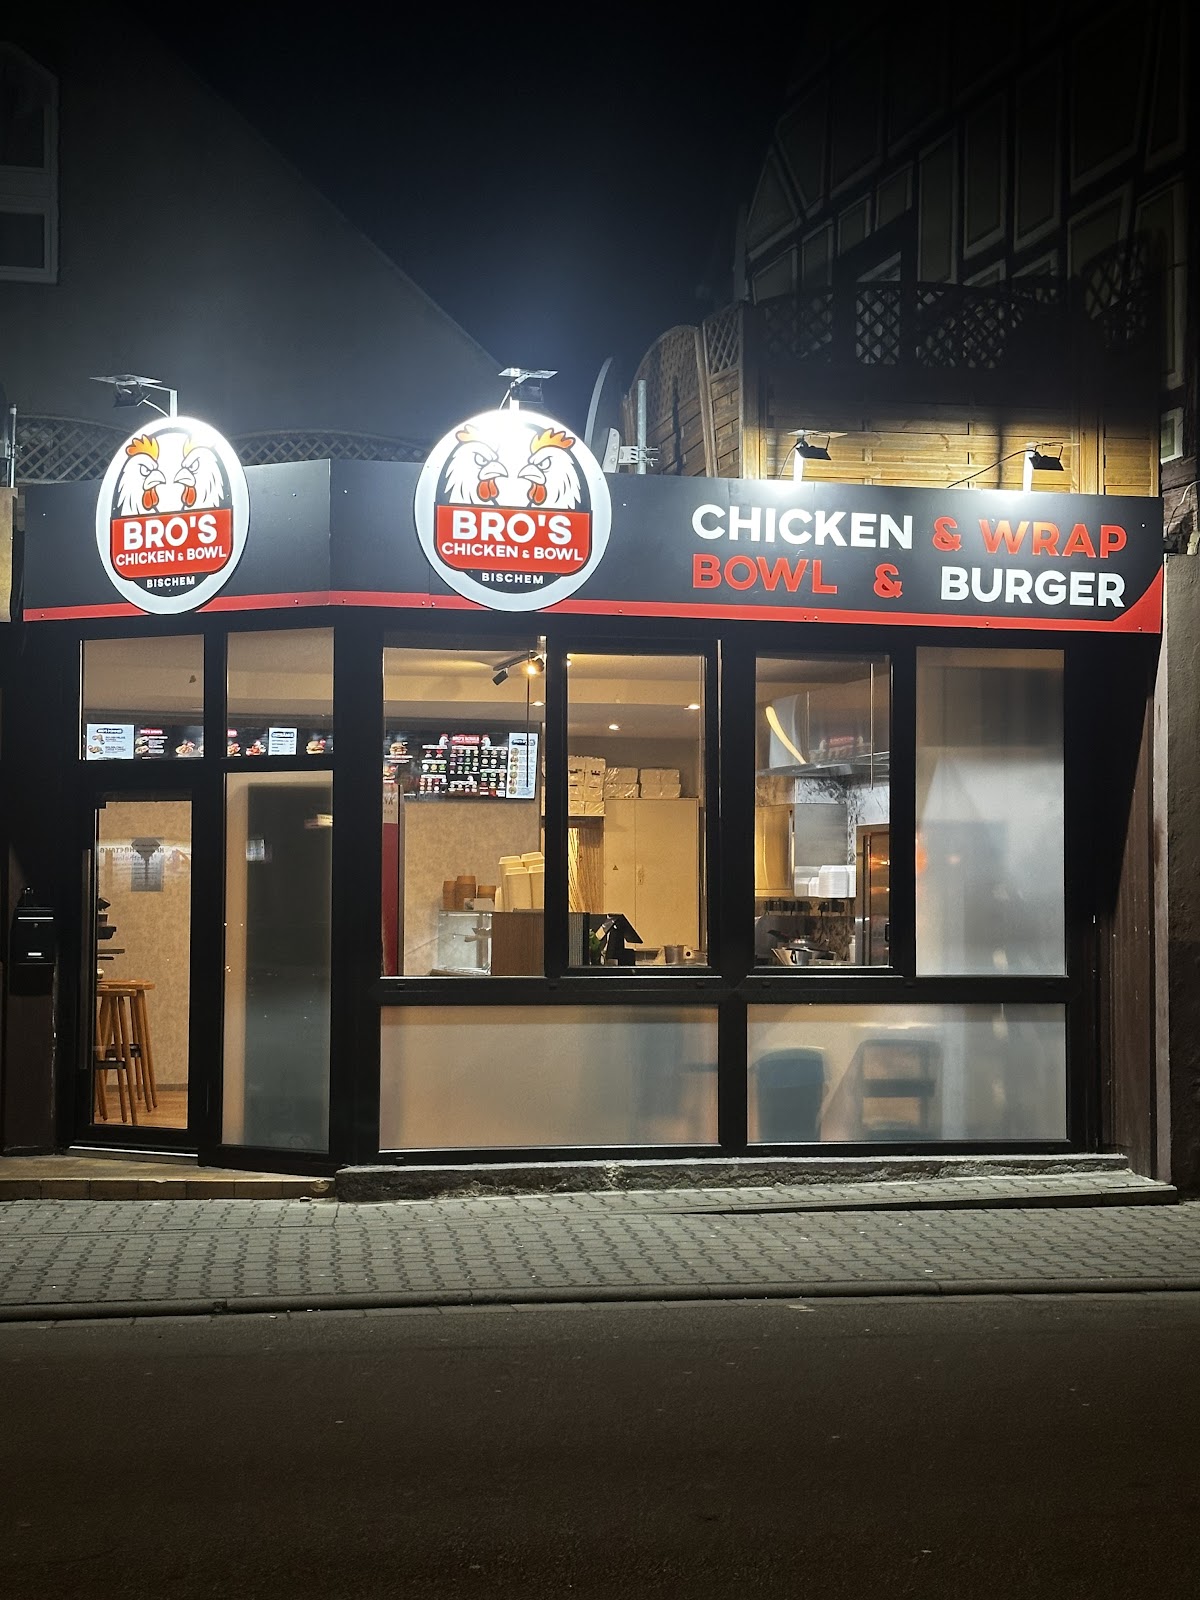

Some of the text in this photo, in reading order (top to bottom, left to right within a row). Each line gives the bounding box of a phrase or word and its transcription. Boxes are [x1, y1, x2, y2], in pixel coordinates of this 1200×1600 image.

[124, 514, 217, 550] BRO'S
[452, 510, 572, 545] BRO'S
[691, 503, 1127, 559] CHICKEN & WRAP
[116, 546, 227, 566] CHICKEN & BOWL
[441, 542, 584, 561] CHICKEN & BOWL
[146, 576, 196, 588] BISCHEM
[482, 572, 544, 585] BISCHEM
[692, 554, 1126, 608] BOWL & BURGER
